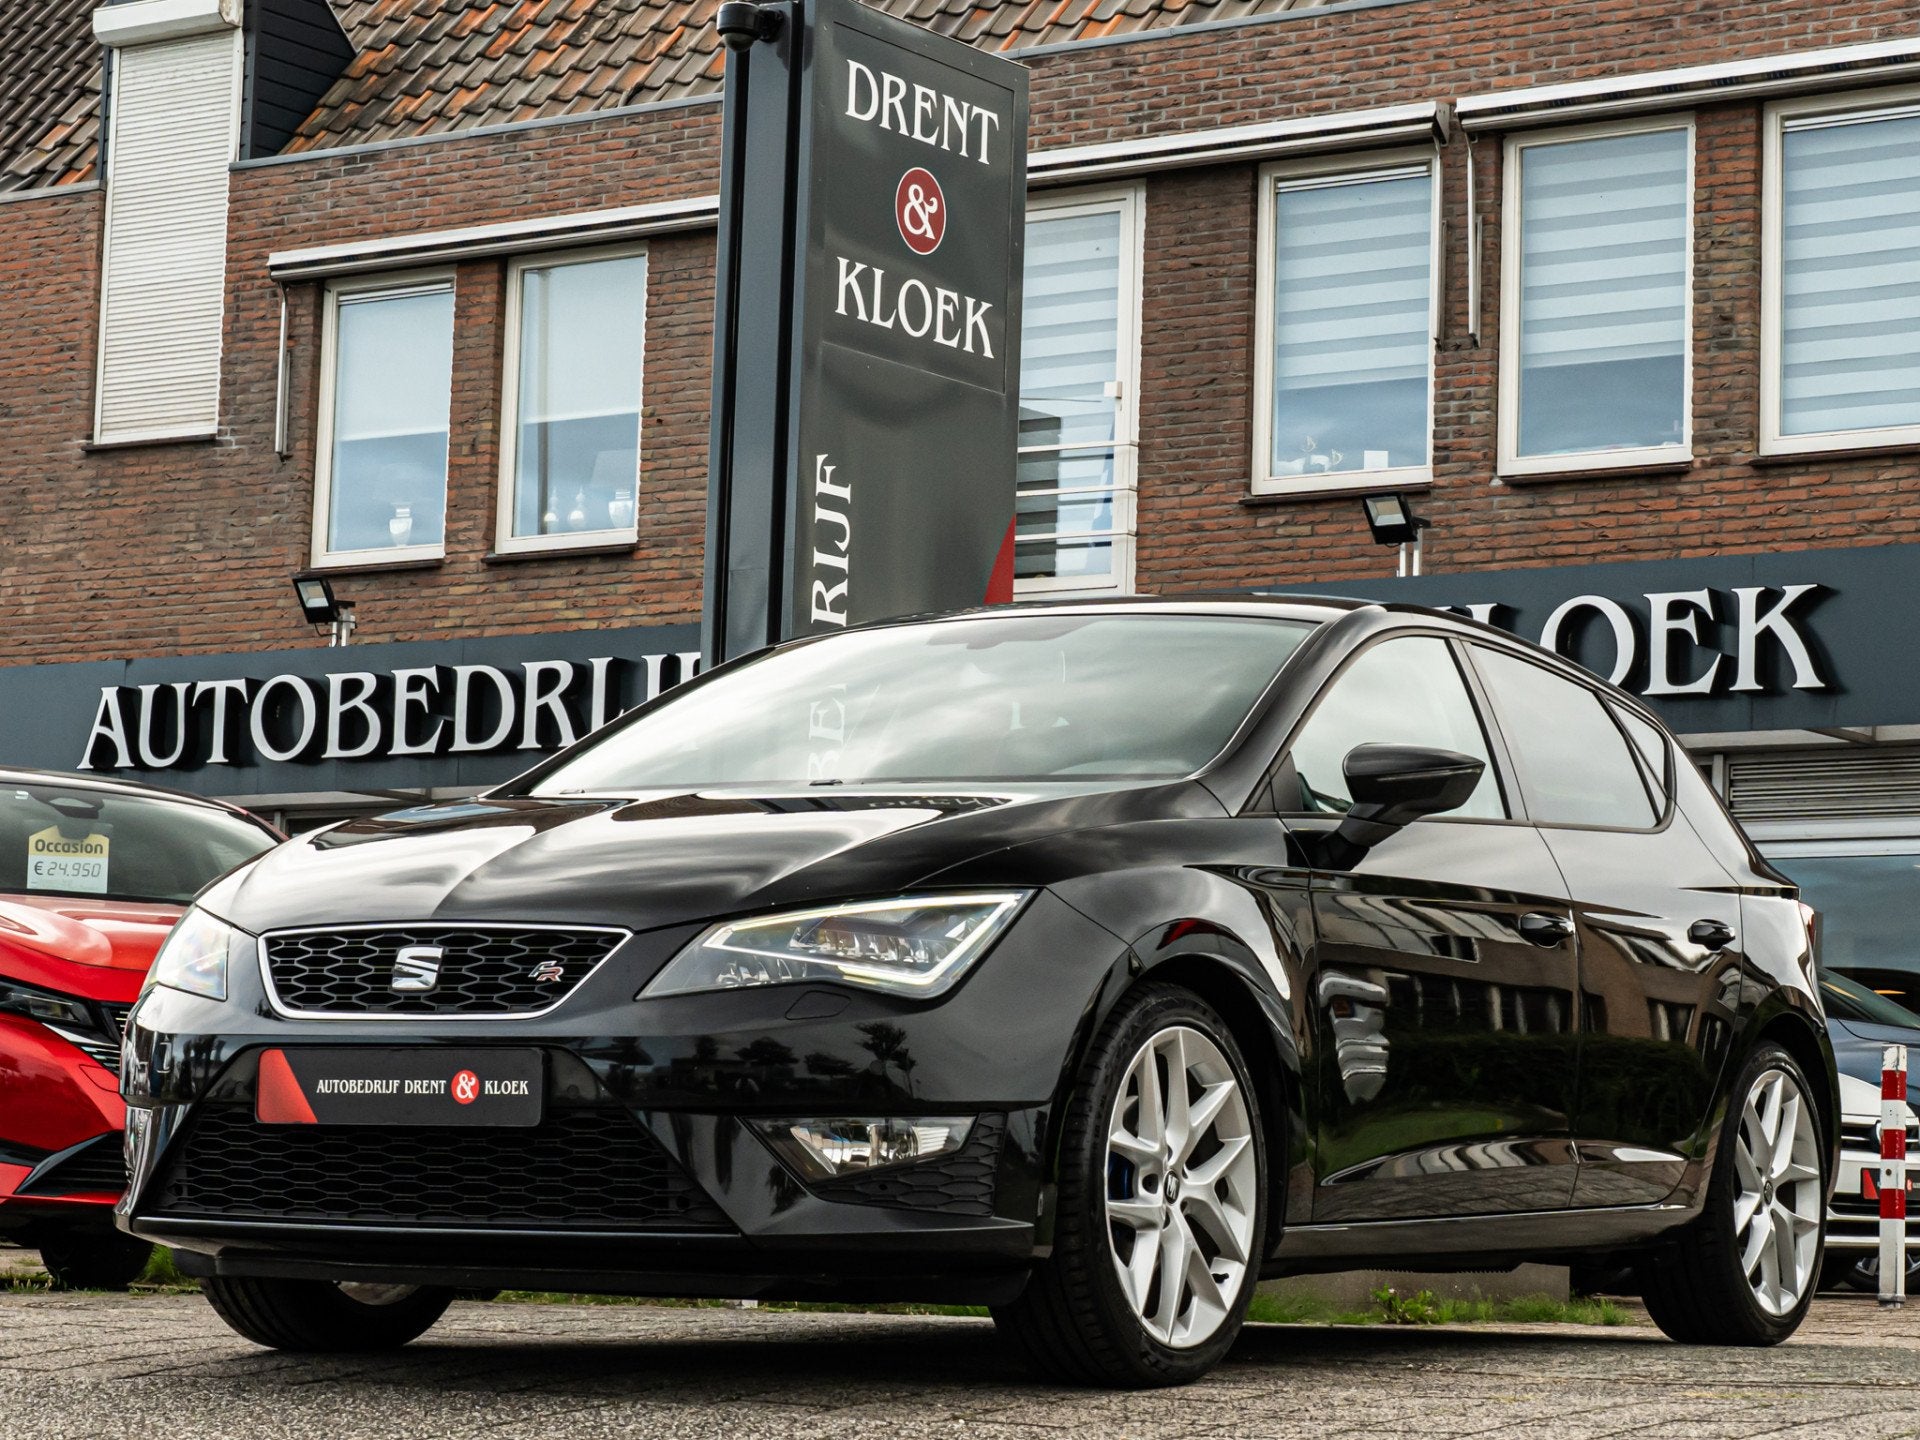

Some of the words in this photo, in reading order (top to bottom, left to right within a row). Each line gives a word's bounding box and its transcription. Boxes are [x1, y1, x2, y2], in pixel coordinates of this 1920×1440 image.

[845, 59, 1000, 165] DRENT
[903, 184, 939, 240] &
[835, 256, 995, 359] KLOEK
[77, 651, 701, 770] AUTOBEDRI
[1434, 584, 1826, 696] OEK
[34, 839, 104, 855] Occasion
[47, 861, 101, 878] 24.950
[527, 960, 565, 983] FR
[316, 1079, 400, 1094] AUTOBEDRIJF
[404, 1079, 447, 1095] DRENT
[456, 1073, 476, 1099] &
[484, 1080, 529, 1095] KLOEK
